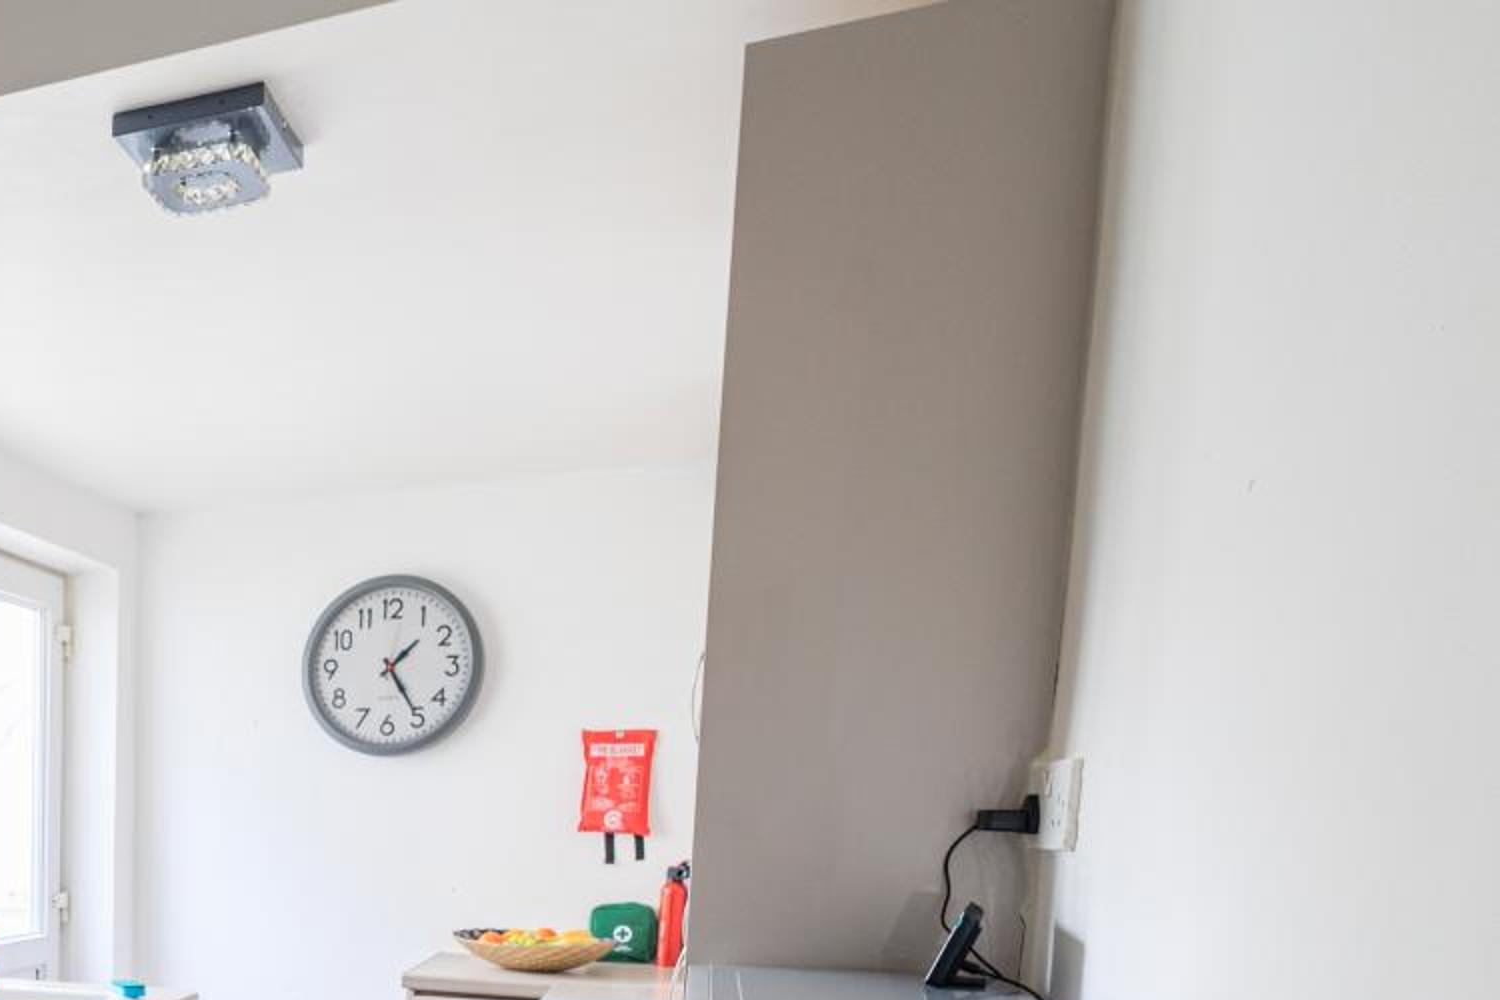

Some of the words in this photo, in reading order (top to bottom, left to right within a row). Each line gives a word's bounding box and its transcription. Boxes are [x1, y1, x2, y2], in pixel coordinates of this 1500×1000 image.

[358, 608, 372, 629] 11
[383, 598, 404, 619] 12
[420, 605, 426, 627] 1
[334, 629, 353, 651] 10
[436, 625, 453, 646] 2
[323, 658, 339, 681] 9
[444, 655, 460, 677] 3
[331, 688, 347, 709] 8
[431, 687, 446, 706] 4
[355, 707, 371, 729] 7
[379, 714, 395, 736] 6
[410, 706, 425, 728] 5
